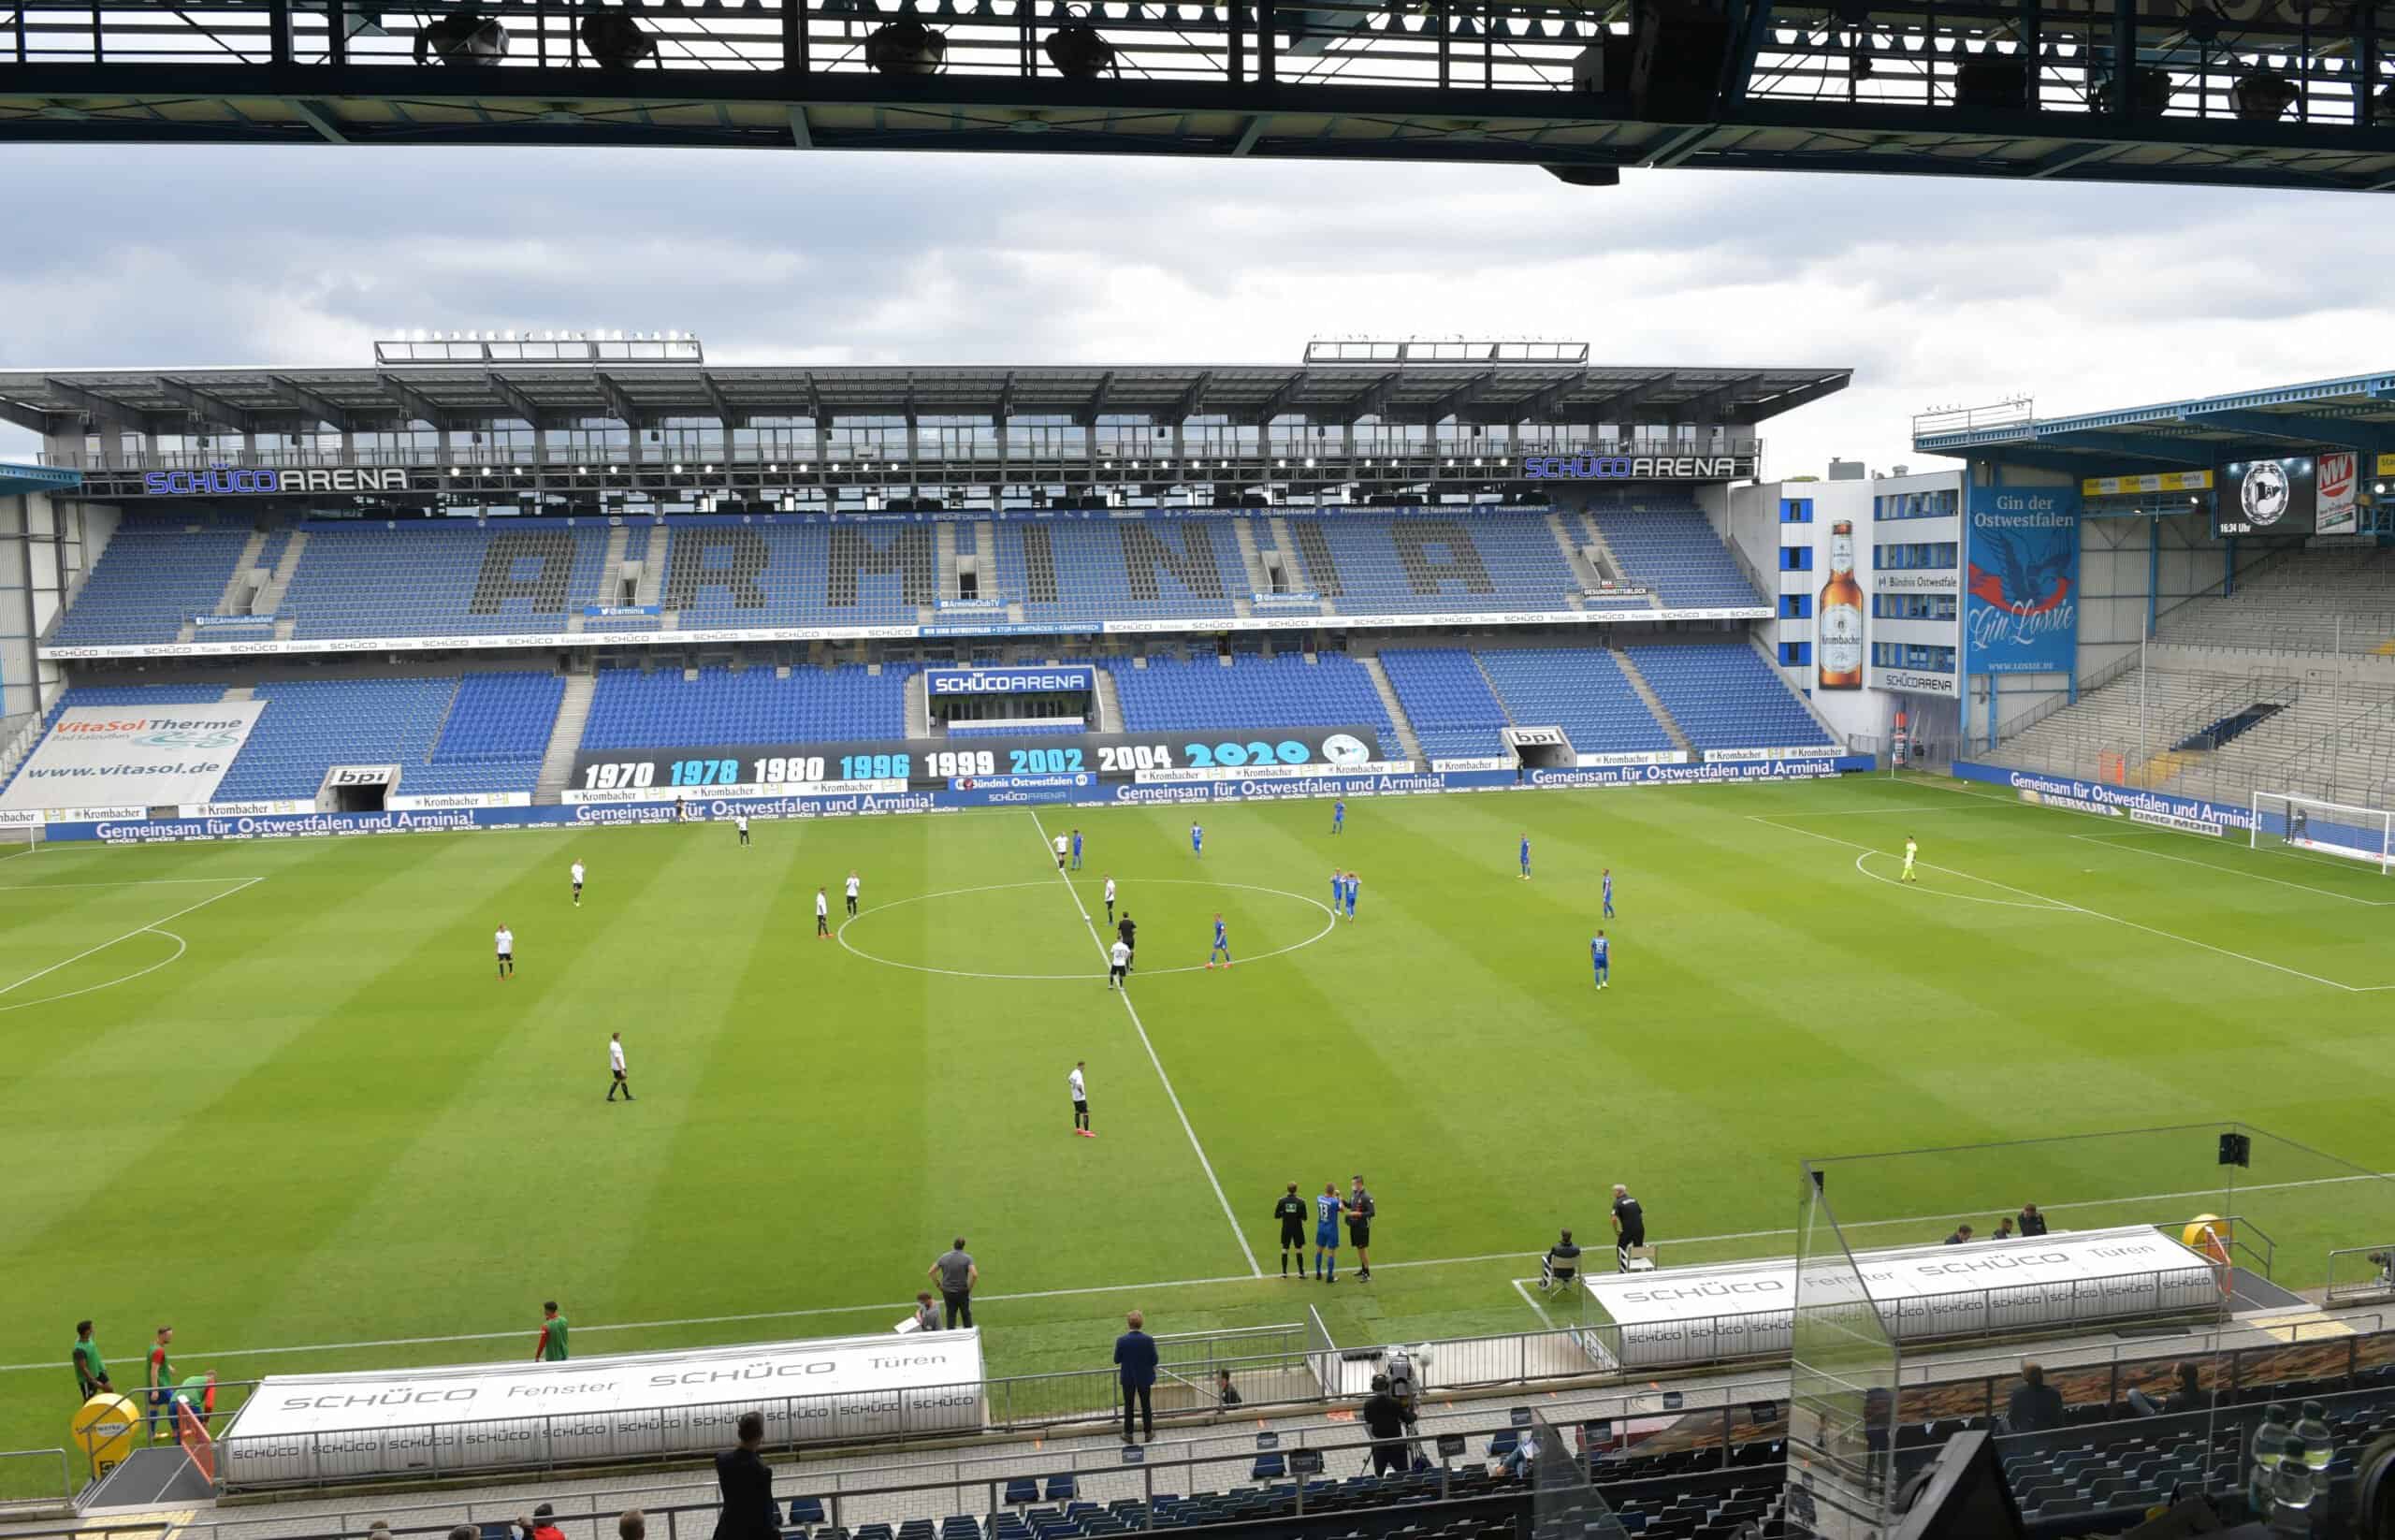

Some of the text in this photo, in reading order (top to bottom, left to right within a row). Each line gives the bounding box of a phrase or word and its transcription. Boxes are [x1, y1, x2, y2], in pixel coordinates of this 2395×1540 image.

[1996, 495, 2053, 510] Gin der
[1974, 512, 2074, 527] Ostwestfalen
[1917, 575, 1957, 588] Ostwestfale
[1968, 605, 2007, 651] Gin
[56, 718, 243, 734] VitaSol Therme
[1515, 732, 1557, 744] bpi
[1603, 754, 1648, 764] Krombacher
[1716, 748, 1842, 760] Krombacher Krombacher
[28, 763, 220, 778] www.vitasol.de
[586, 740, 1311, 789] 1970 1978 1980 1996 1999 2002 2004 2020
[1149, 763, 1385, 780] Krombacher Krombacher Krombacher
[1444, 761, 1492, 771] Krombacher
[1532, 768, 1617, 784] Gemeinsam
[1621, 767, 1642, 781] für
[1647, 763, 1739, 779] Ostwestfalen
[1743, 761, 1770, 776] und
[1774, 759, 1835, 775] Arminia!
[338, 770, 385, 785] bpi
[1011, 776, 1072, 787] Ostwestfalen
[582, 781, 874, 802] Krombacher Krombacher Krombacher
[1116, 784, 1209, 800] Gemeinsam
[1212, 781, 1237, 796] für
[1241, 778, 1343, 795] Ostwestfalen
[1348, 777, 1375, 792] und
[1380, 773, 1445, 790] Arminia!
[424, 796, 479, 807] Krombacher
[576, 804, 677, 821] Gemeinsam
[683, 801, 706, 818] für
[711, 798, 820, 817] Ostwestfalen
[825, 795, 855, 812] und
[863, 792, 935, 810] Arminia!
[2010, 772, 2262, 830] Gemeinsam für Ostwestfalen und Arminia!
[2043, 794, 2106, 815] MERKUR
[0, 807, 140, 823] mbacher Krombacher
[208, 803, 269, 816] Krombacher
[96, 820, 201, 838] Gemeinsam
[207, 819, 233, 834] für
[238, 813, 355, 833] Ostwestfalen
[359, 811, 391, 830] und
[397, 809, 474, 828] Arminia!
[1623, 1281, 1784, 1303] SCHÜCO
[1917, 1253, 2070, 1276] SCHÜCO
[2088, 1243, 2156, 1258] Türen
[1628, 1330, 1682, 1344] SCHÜCO
[1691, 1324, 1743, 1338] SCHÜCO
[1881, 1307, 1924, 1319] CHÜCO
[1932, 1300, 1983, 1315] SCHÜCO
[1993, 1295, 2041, 1308] SCHÜCO
[2050, 1288, 2098, 1301] SCHÜCO
[2106, 1283, 2155, 1297] SCHÜCO
[2162, 1276, 2211, 1289] SCHÜCO
[281, 1354, 947, 1411] SCHÜCO Fenster SCHÜCO Türen
[232, 1445, 299, 1460] SCHÜCO
[312, 1440, 376, 1455] SCHÜCO
[388, 1434, 454, 1449] SCHÜCO
[466, 1429, 530, 1445] SCHÜCO
[542, 1422, 606, 1439] SCHÜCO
[617, 1417, 681, 1432] SCHÜCO
[692, 1413, 746, 1428] SCHÜC
[766, 1406, 829, 1422] SCHÜCO
[912, 1394, 973, 1410] SCHÜCO
